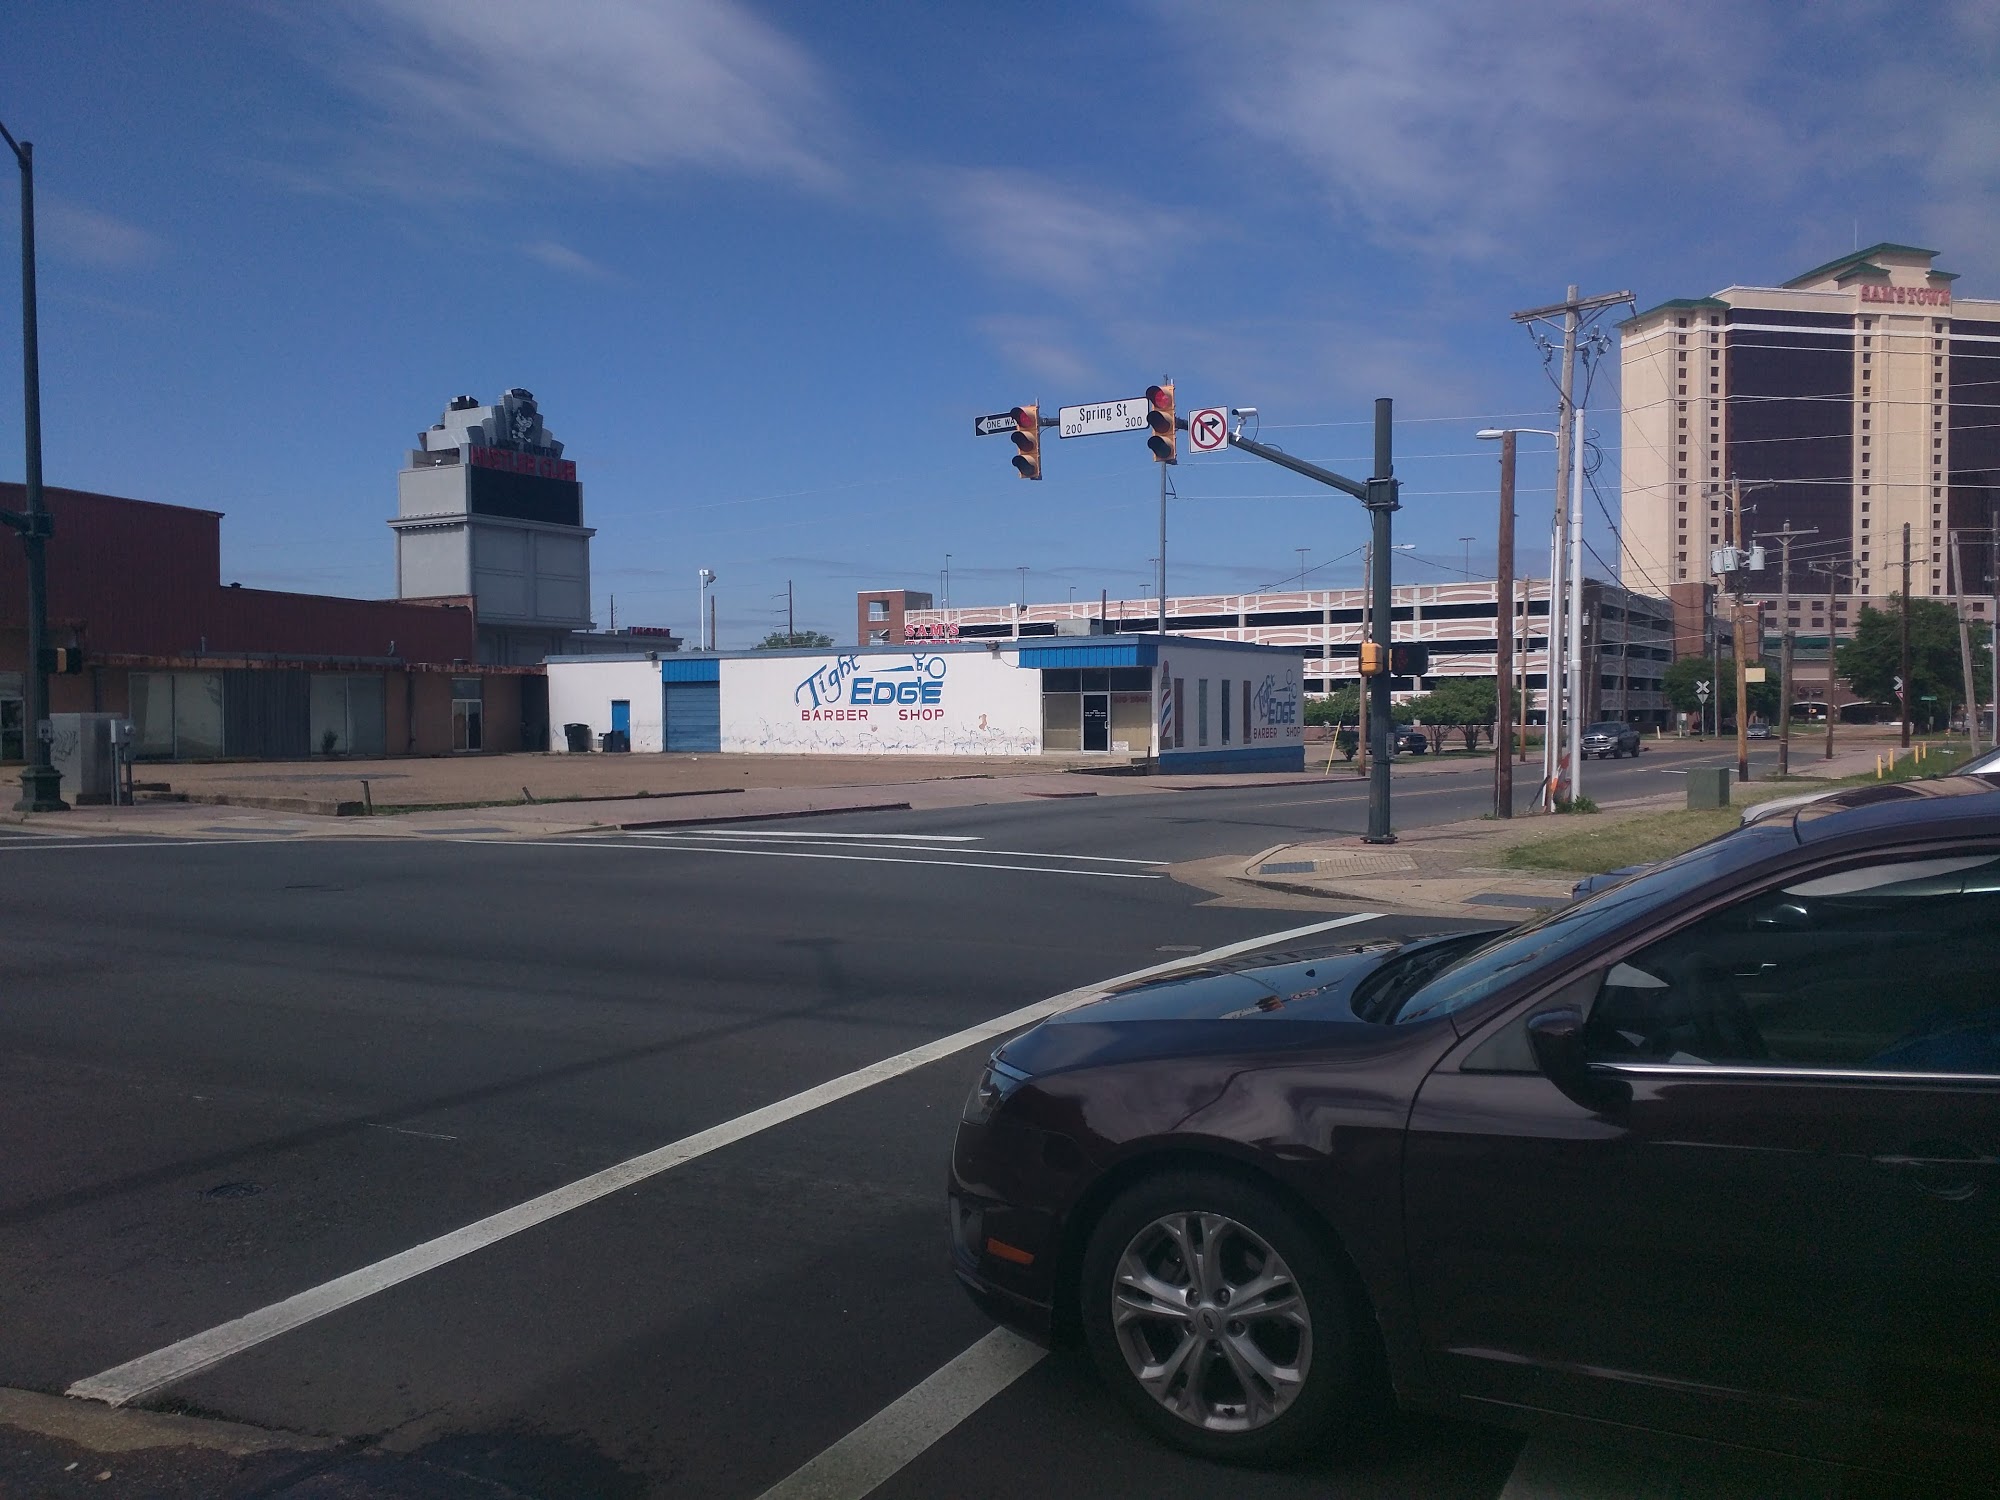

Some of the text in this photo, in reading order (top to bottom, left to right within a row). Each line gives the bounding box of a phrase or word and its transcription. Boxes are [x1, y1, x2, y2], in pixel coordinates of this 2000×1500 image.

[1080, 403, 1128, 423] Spring St
[986, 418, 1016, 430] ONE WA
[1065, 416, 1143, 435] 200 300
[905, 622, 959, 637] SAM'S
[795, 654, 861, 710] Tight
[850, 677, 944, 706] EDGE
[802, 708, 944, 721] BARBER SHOP
[1267, 697, 1296, 725] EDGE
[1253, 726, 1301, 739] BARBER SHOP
